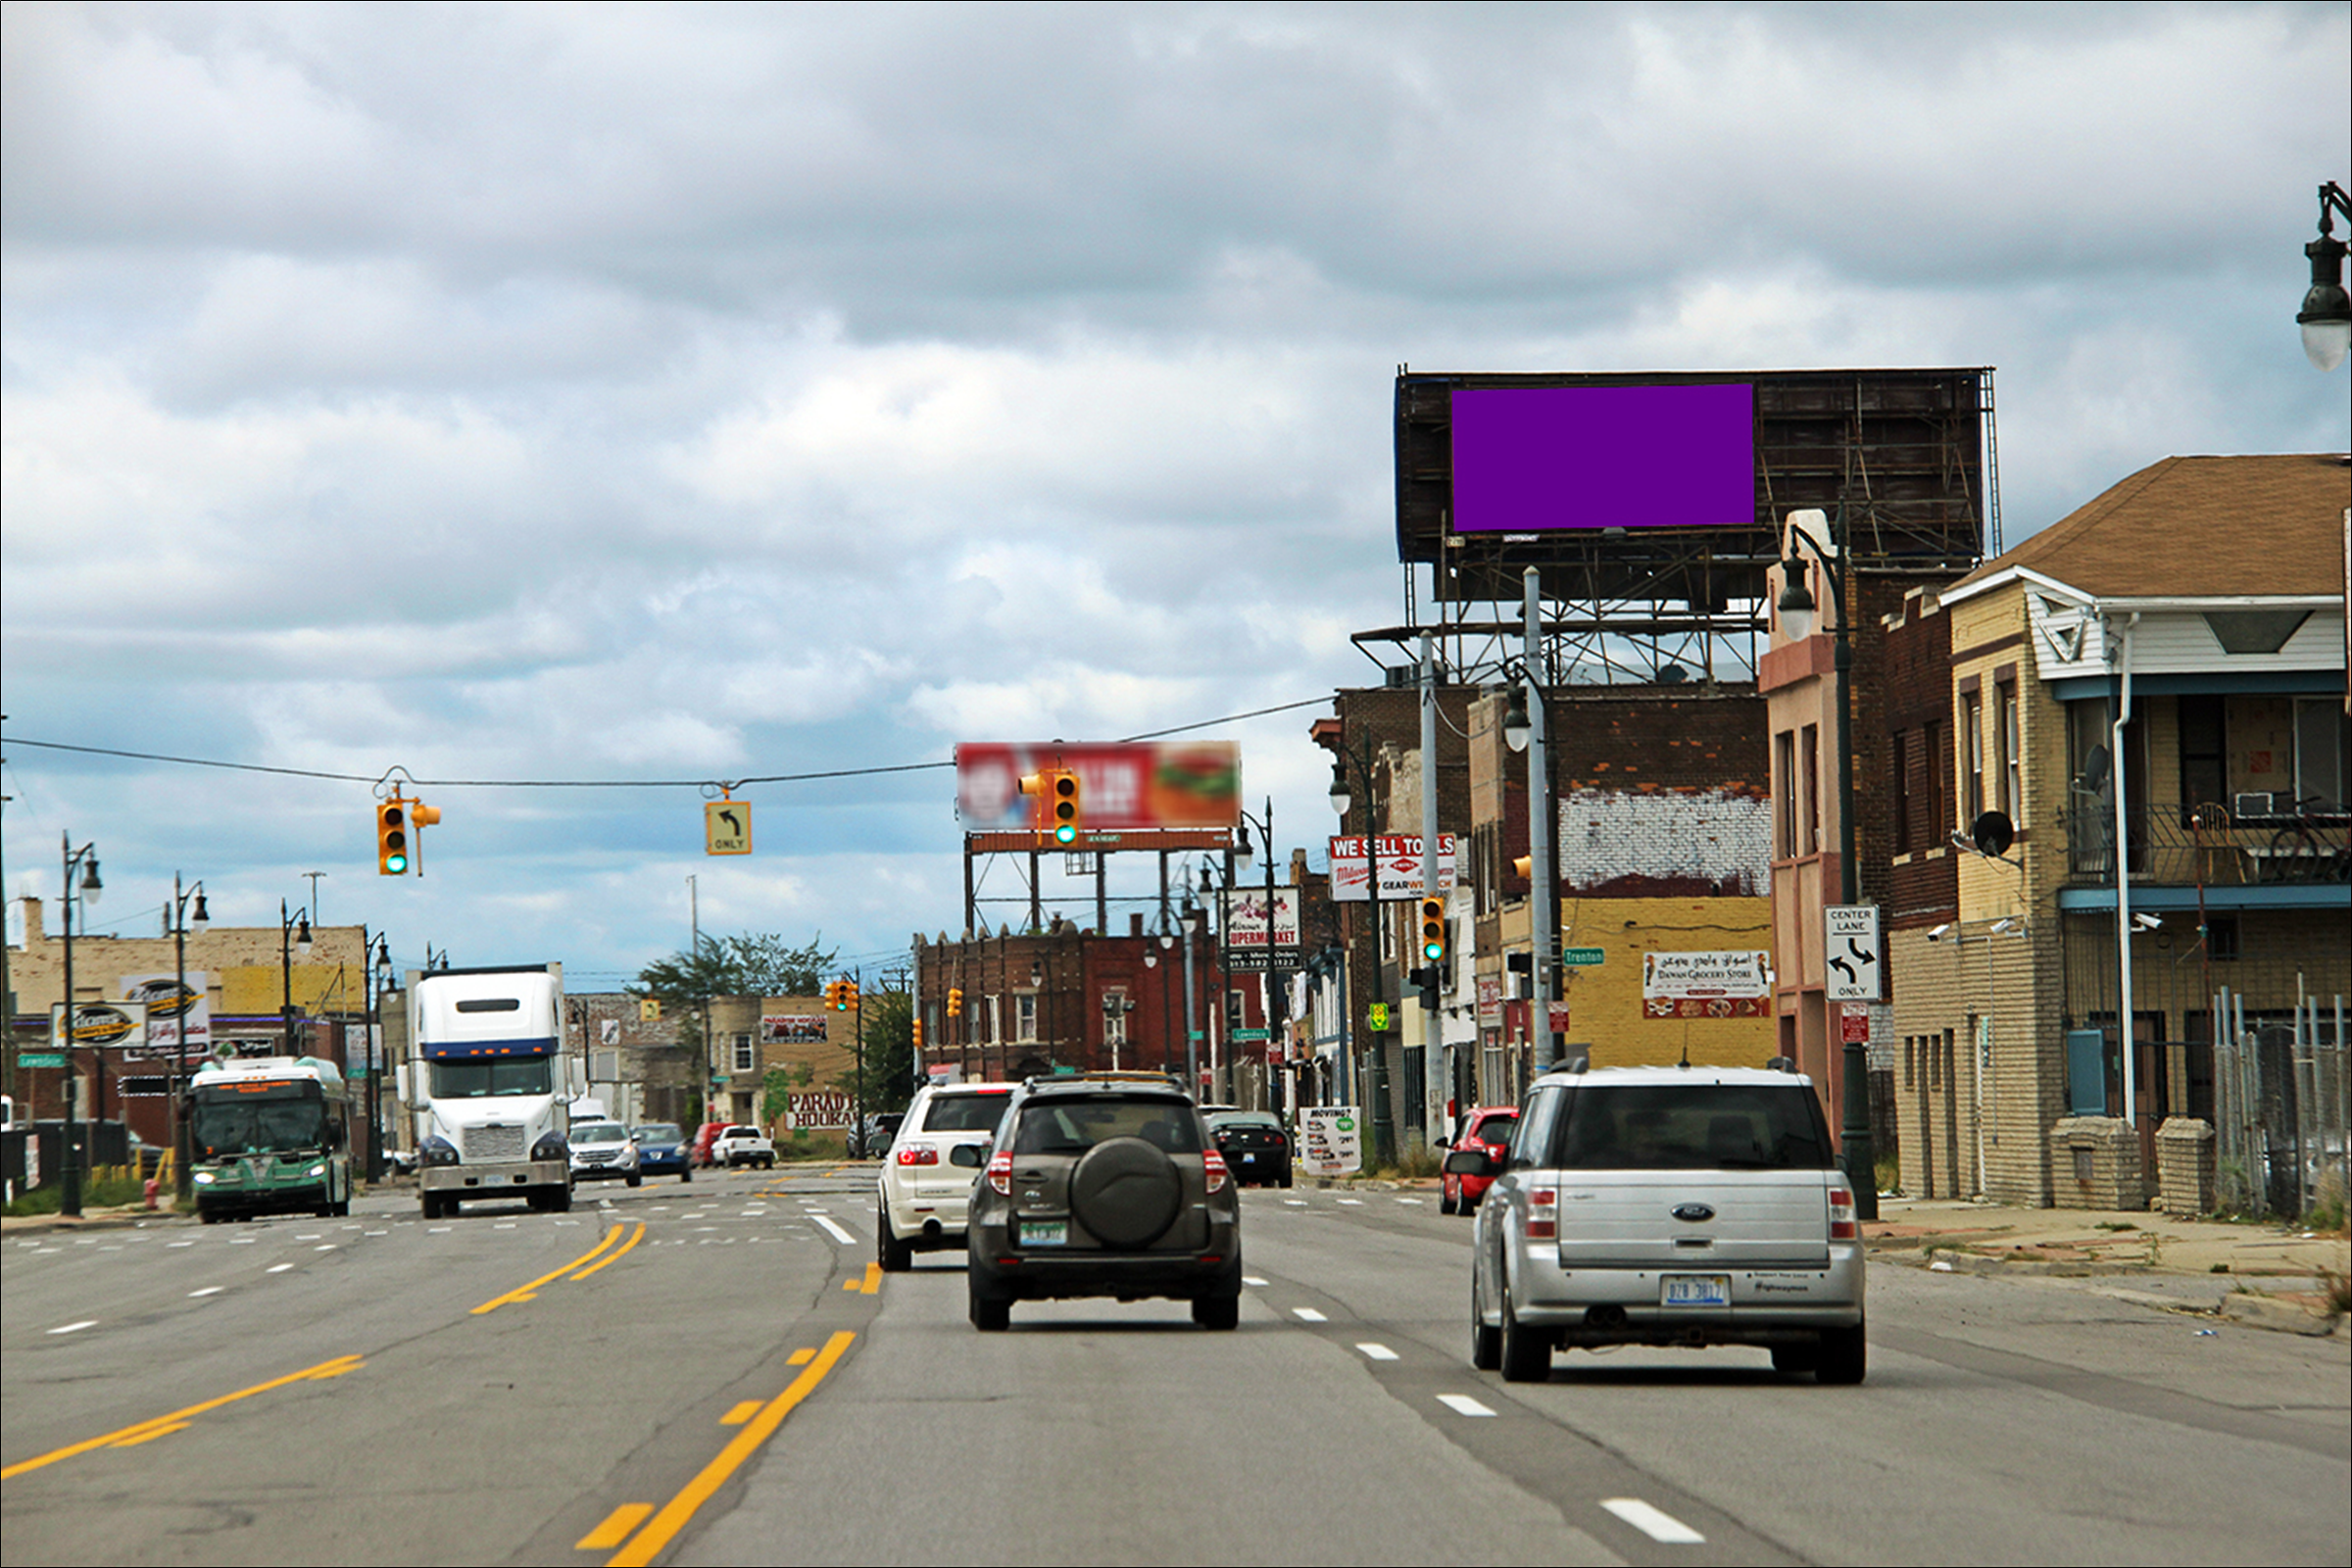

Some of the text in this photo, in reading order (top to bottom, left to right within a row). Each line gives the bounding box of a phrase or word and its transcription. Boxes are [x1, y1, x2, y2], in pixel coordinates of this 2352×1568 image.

[714, 839, 745, 850] ONLY
[1334, 837, 1454, 857] WE SELL TOLS
[1382, 880, 1451, 890] GEARWRCH
[1831, 910, 1871, 919] CENTER
[1229, 931, 1296, 945] UPERMAKET
[1566, 952, 1601, 962] Trenton
[1658, 969, 1752, 980] DAWAN GROCERY STORE
[1838, 987, 1867, 996] ONLY
[788, 1092, 854, 1112] PARADI
